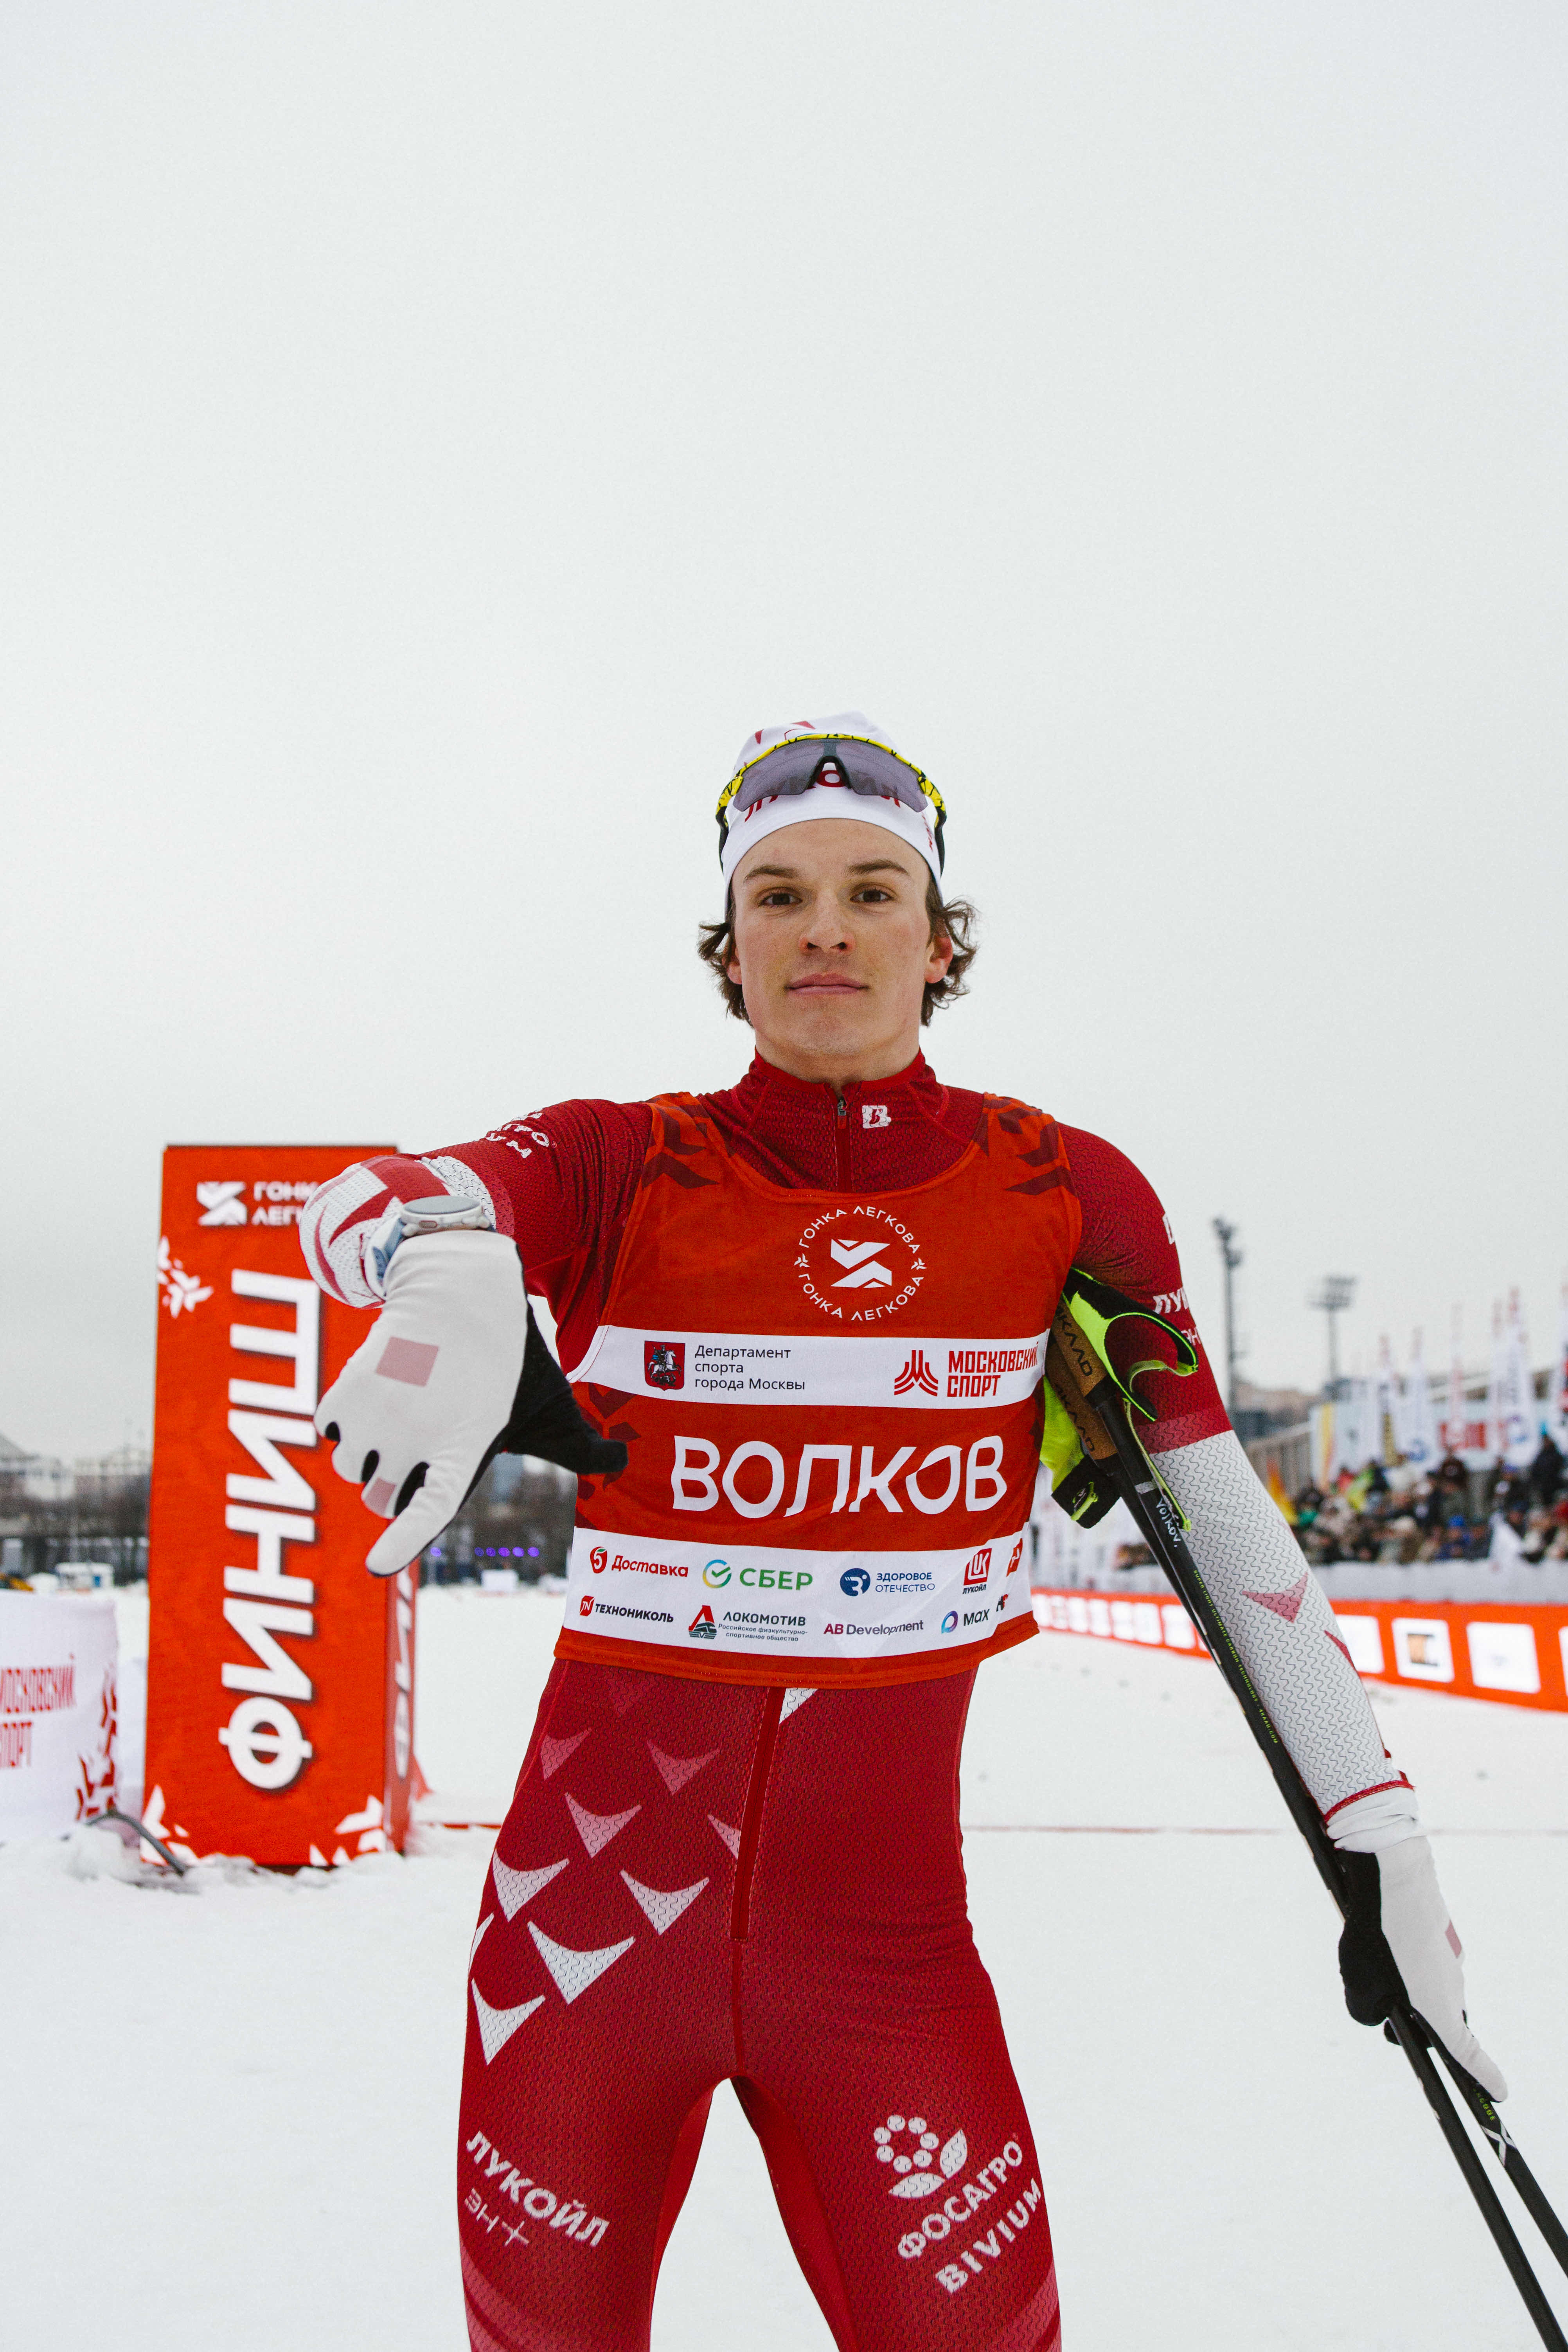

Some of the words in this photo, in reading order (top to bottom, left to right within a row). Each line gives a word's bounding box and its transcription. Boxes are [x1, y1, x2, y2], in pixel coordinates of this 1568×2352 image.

[254, 1181, 319, 1202] ГОНК
[252, 1205, 302, 1226] ЛЕГ
[799, 1208, 847, 1248] ГОНКА
[853, 1205, 921, 1253] ЛЕГКОВА
[798, 1273, 842, 1318] ГОНКА
[851, 1276, 924, 1321] ЛЕГКОВА
[694, 1345, 791, 1360] Департамент
[948, 1341, 1039, 1374] МОСКОВСКИЙ
[695, 1363, 744, 1376] спорта
[695, 1378, 744, 1391] города
[749, 1378, 805, 1390] Москвы
[947, 1375, 1001, 1397] СПОРТ
[672, 1435, 1008, 1519] ВОЛКОВ
[218, 1268, 320, 1790] ФИНИШ
[611, 1555, 689, 1577] Доставка
[739, 1568, 813, 1591] СБЕР
[876, 1572, 932, 1582] ЗДОРОВОЕ
[875, 1583, 935, 1593] ОТЕЧЕСТВО
[962, 1584, 987, 1595] ЛУКОЙЛ
[595, 1603, 674, 1623] ТЕХНОНИКОЛЬ
[723, 1611, 806, 1626] ЛОКОМОТИВ
[718, 1623, 757, 1632] Российское
[758, 1626, 808, 1635] физкультурно-
[726, 1632, 765, 1640] спортивное
[824, 1623, 844, 1635] AB
[845, 1619, 924, 1636] Development
[466, 2131, 610, 2247] ЛУКОЙЛ
[898, 2140, 1023, 2259] ФОСАГРО
[464, 2187, 529, 2247] ЭН+
[935, 2178, 1041, 2293] BIVIUM
